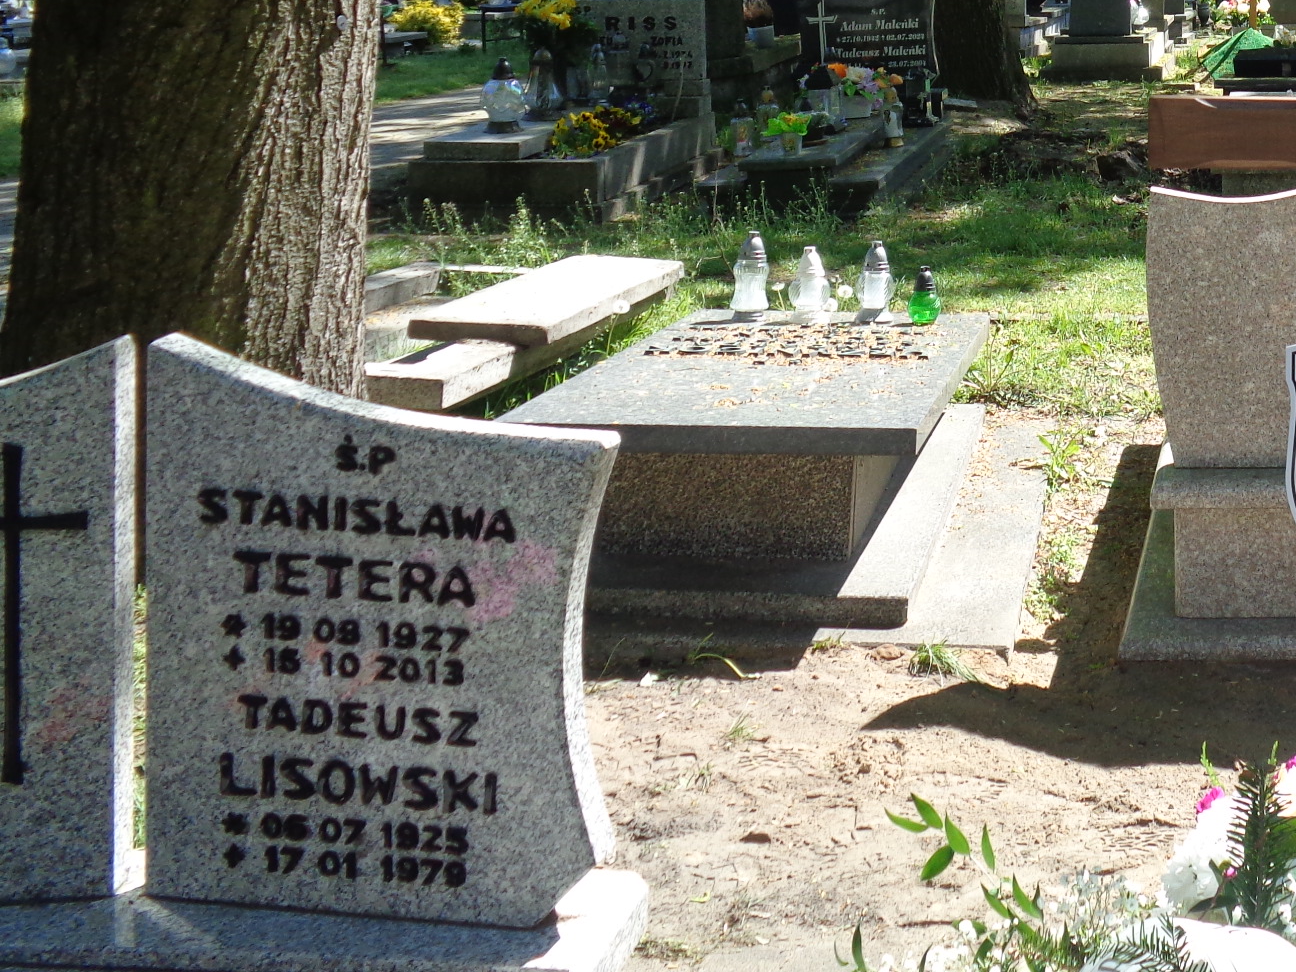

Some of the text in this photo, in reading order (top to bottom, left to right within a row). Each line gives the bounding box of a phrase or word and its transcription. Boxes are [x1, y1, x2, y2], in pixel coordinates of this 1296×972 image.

[604, 15, 678, 32] RISS
[839, 20, 873, 33] Adam
[650, 36, 683, 47] ZOFIA
[197, 487, 516, 543] STANISŁAWA
[233, 550, 476, 607] TETERA
[375, 620, 470, 653] 1927
[320, 651, 361, 679] 10
[373, 654, 465, 685] 2013
[237, 693, 479, 747] TADEUSZ
[219, 751, 498, 815] LISOWSKI
[318, 817, 367, 845] 07
[264, 845, 305, 874] 17
[317, 850, 358, 879] 01
